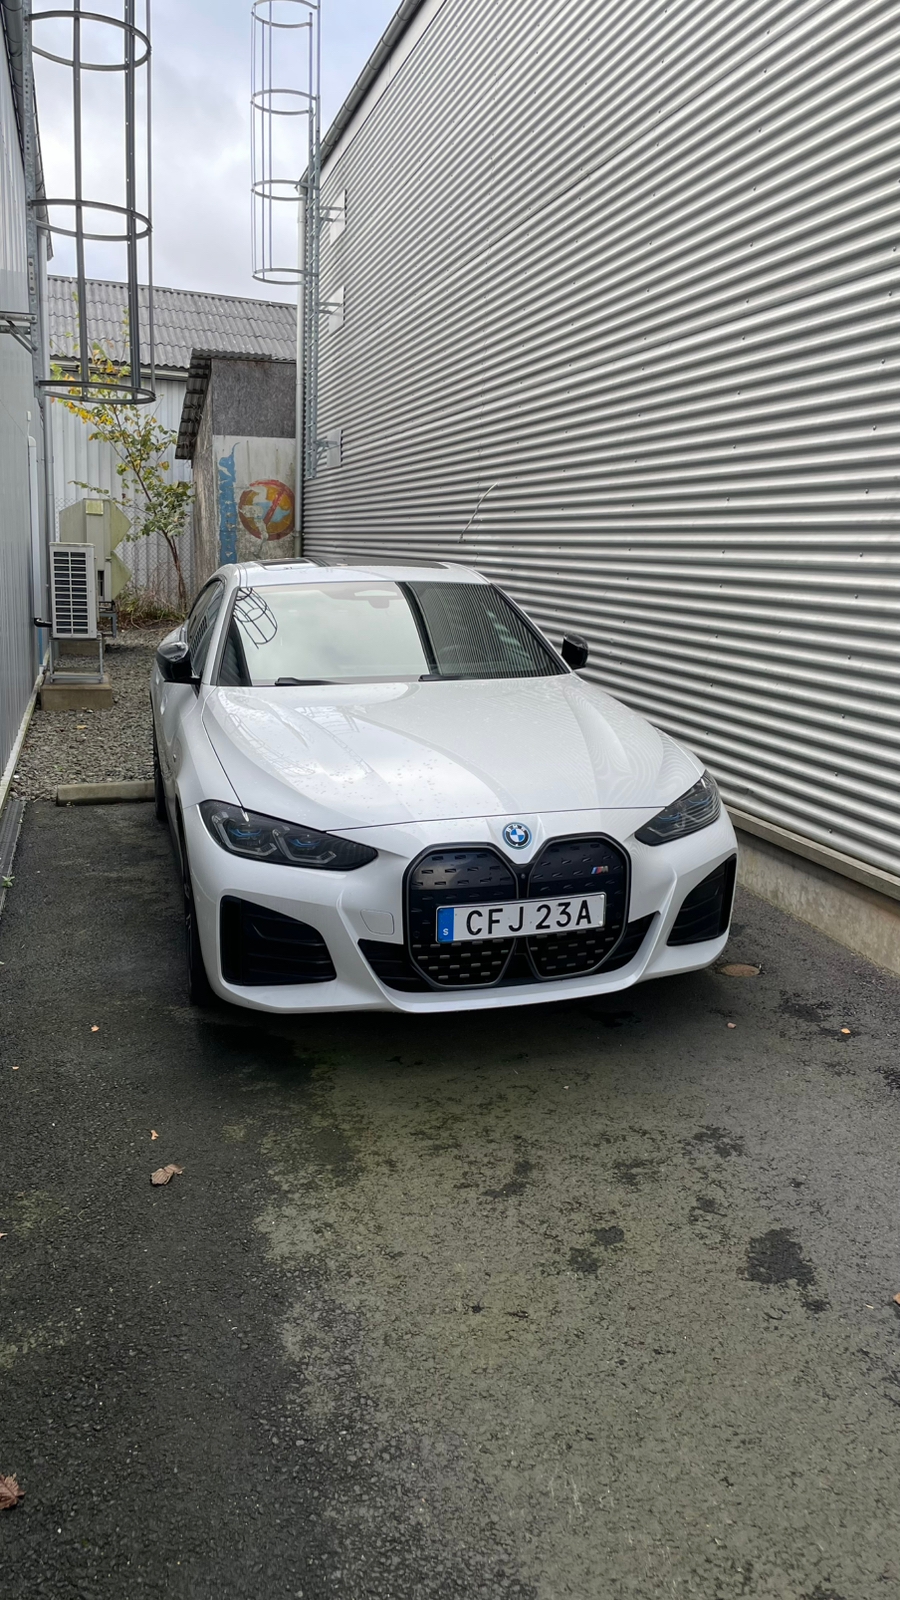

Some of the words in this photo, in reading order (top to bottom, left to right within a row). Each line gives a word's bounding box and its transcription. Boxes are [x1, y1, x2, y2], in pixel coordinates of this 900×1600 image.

[466, 906, 524, 936] CFJ
[535, 899, 592, 930] 23A
[442, 928, 449, 936] S
